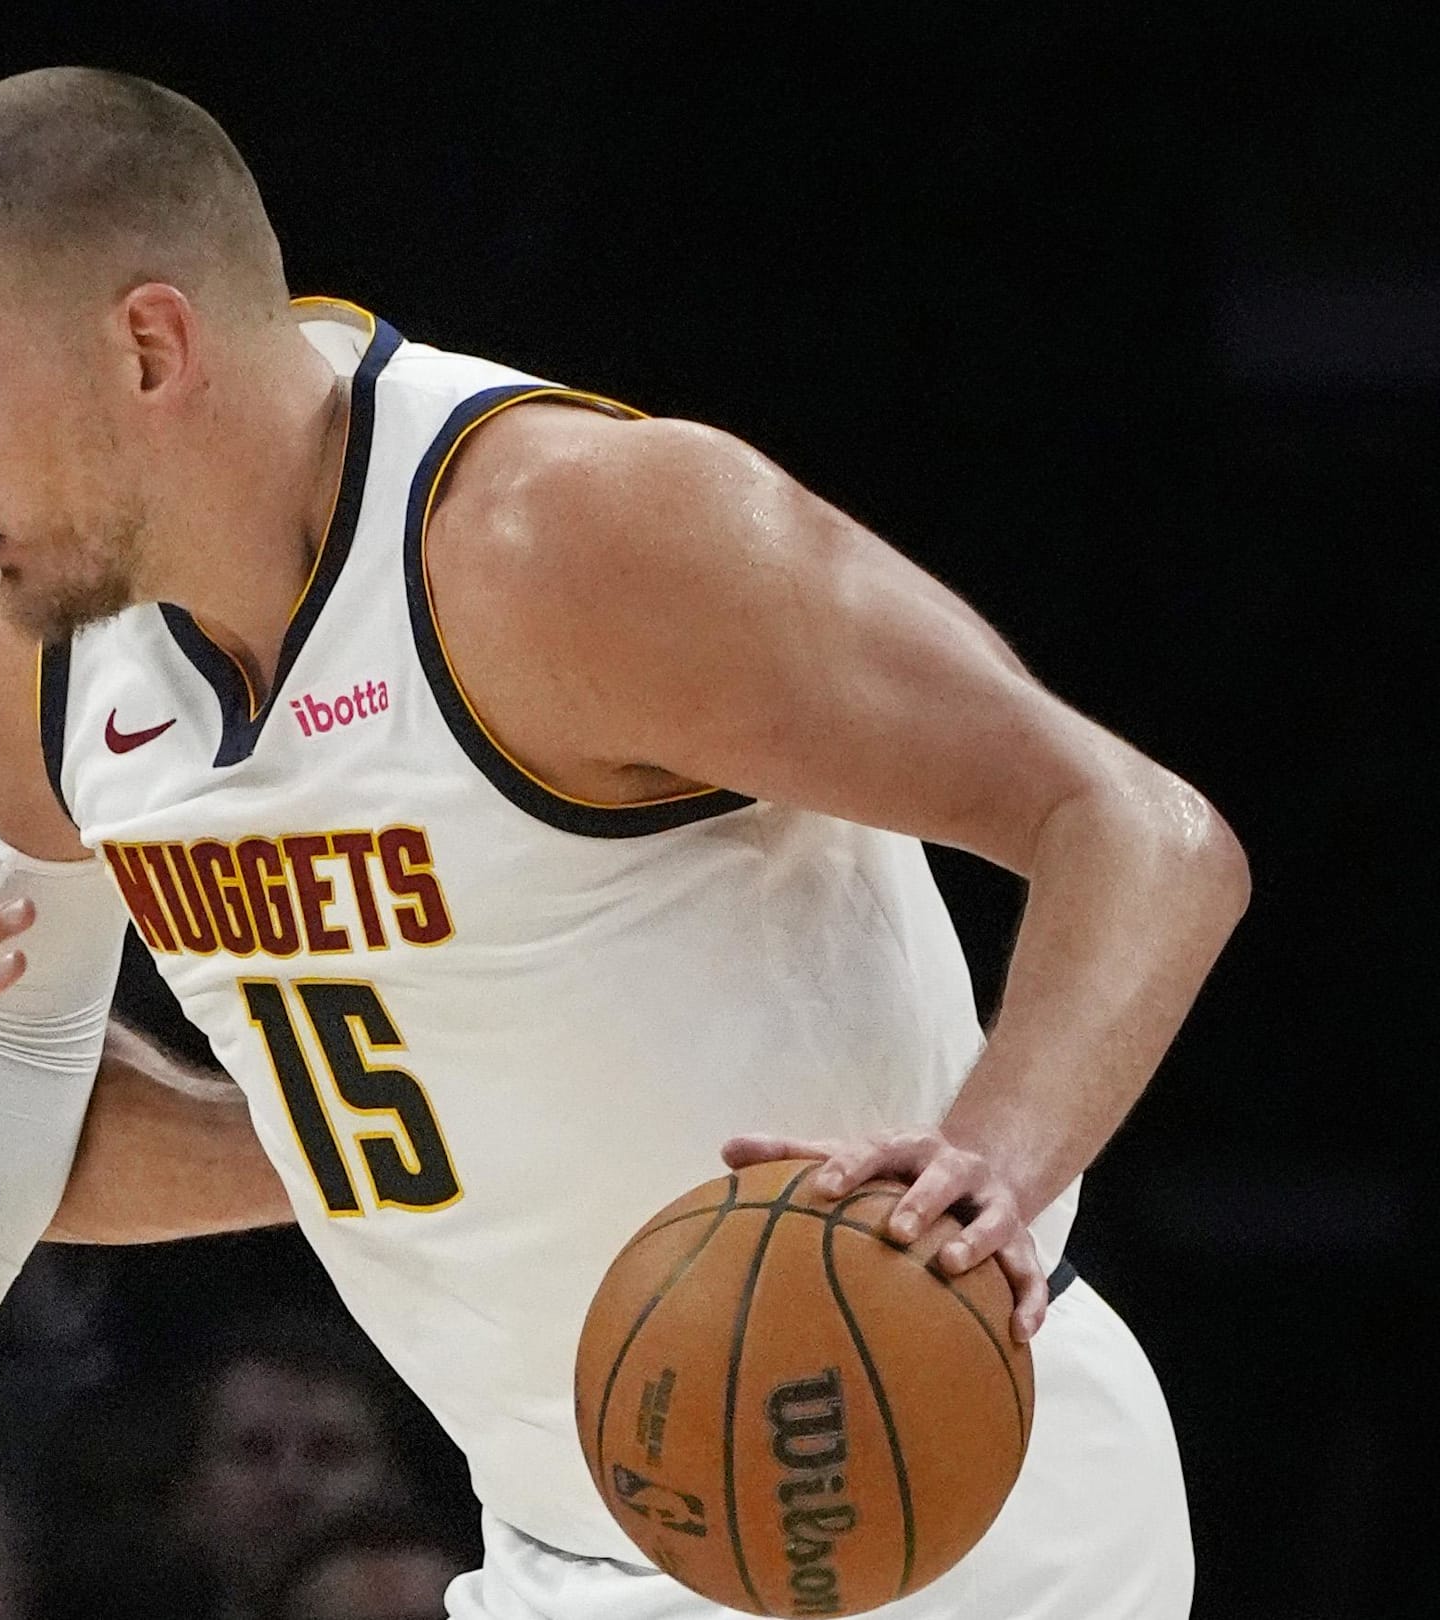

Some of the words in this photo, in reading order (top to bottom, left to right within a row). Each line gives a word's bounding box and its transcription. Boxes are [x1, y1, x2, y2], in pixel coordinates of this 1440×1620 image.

[288, 679, 390, 738] ibotta
[100, 822, 457, 960] NUGGETS
[236, 975, 465, 1218] 15
[766, 1365, 857, 1616] Wilson
